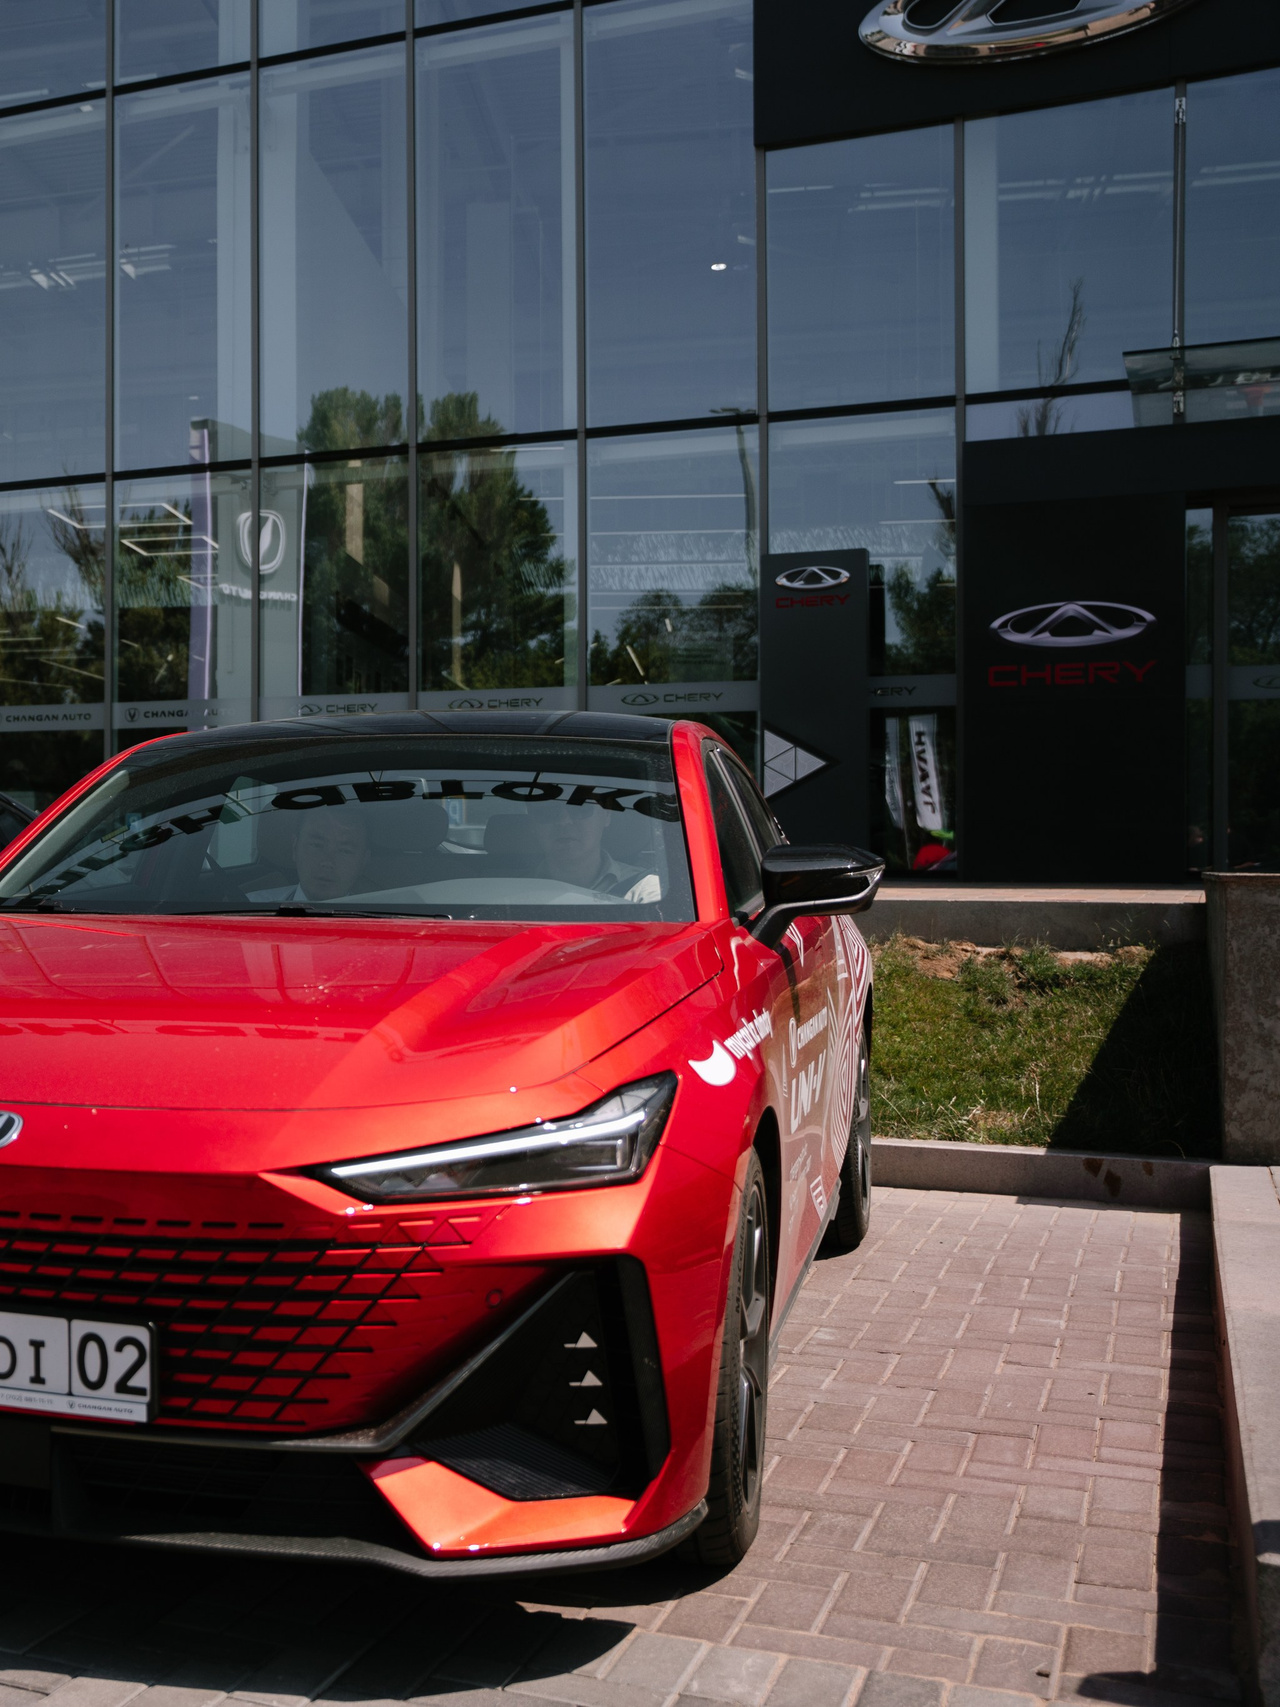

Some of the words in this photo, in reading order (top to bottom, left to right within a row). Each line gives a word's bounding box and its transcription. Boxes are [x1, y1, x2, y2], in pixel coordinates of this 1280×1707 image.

[775, 594, 850, 609] CHERY
[987, 660, 1158, 687] CHERY
[487, 697, 544, 709] CHERY
[662, 692, 724, 703] CHERY
[325, 703, 378, 713] CHERY
[5, 713, 58, 723] CHANGAN
[61, 712, 92, 721] AUTO
[76, 1331, 148, 1398] 02
[77, 1402, 113, 1413] CHANGAN
[113, 1407, 134, 1415] AUTO
